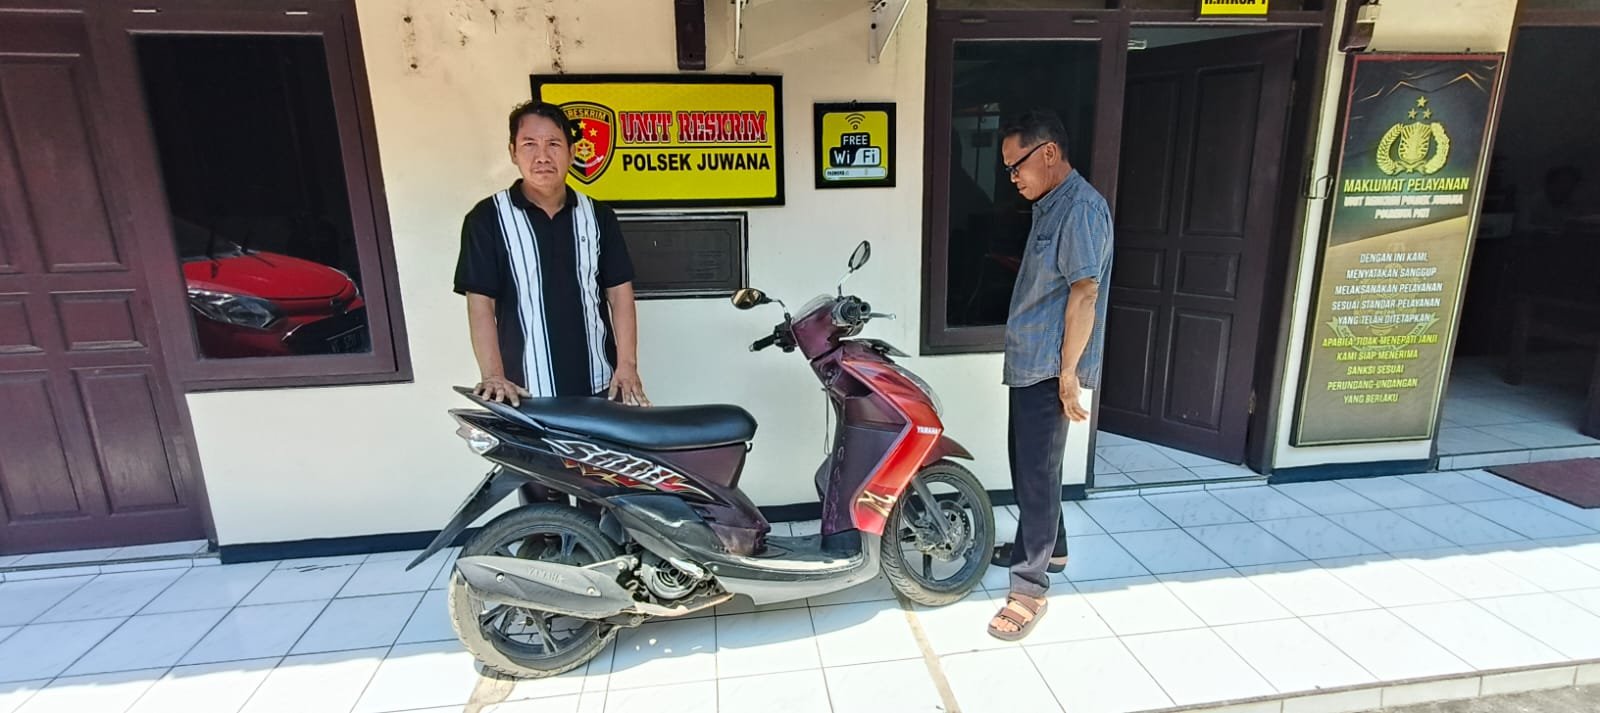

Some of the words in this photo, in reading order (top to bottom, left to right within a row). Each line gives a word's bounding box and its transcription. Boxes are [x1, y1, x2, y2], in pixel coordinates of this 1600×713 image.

[619, 111, 673, 143] UNIT
[676, 111, 768, 143] RESKRIM
[843, 135, 868, 145] FREE
[622, 154, 692, 171] POLSEK
[697, 153, 770, 171] JUWANA
[1344, 179, 1406, 192] MAKLUMAT
[1407, 177, 1470, 191] PELAYANAN
[1360, 253, 1392, 263] DENGAN
[1393, 252, 1406, 262] INI
[1346, 268, 1399, 279] MENYATAKAN
[1399, 267, 1437, 277] SANGGUP
[1335, 284, 1398, 295] MELAKSANAKAN
[1399, 282, 1443, 292] PELAYANAN
[1332, 301, 1360, 311] SESUAI
[1361, 300, 1396, 309] STANDAR
[1397, 298, 1441, 308] PELAYANAN
[1338, 315, 1359, 325] YANG
[1361, 314, 1385, 324] TELAH
[1385, 313, 1431, 323] DITETAPKAN
[1322, 338, 1353, 347] APABILA
[1356, 336, 1378, 346] TIDAK
[1380, 335, 1417, 345] MENEPATI
[1418, 334, 1438, 344] JANJI
[1337, 351, 1357, 361] KAMI
[1358, 350, 1377, 360] SIAP
[1378, 349, 1418, 359] MENERIMA
[1347, 366, 1376, 375] SANKSI
[1377, 364, 1405, 374] SESUAI
[1327, 378, 1418, 390] PERUNDANG-UNDANGAN
[1344, 394, 1365, 404] YANG
[1365, 393, 1399, 403] BERLAKU
